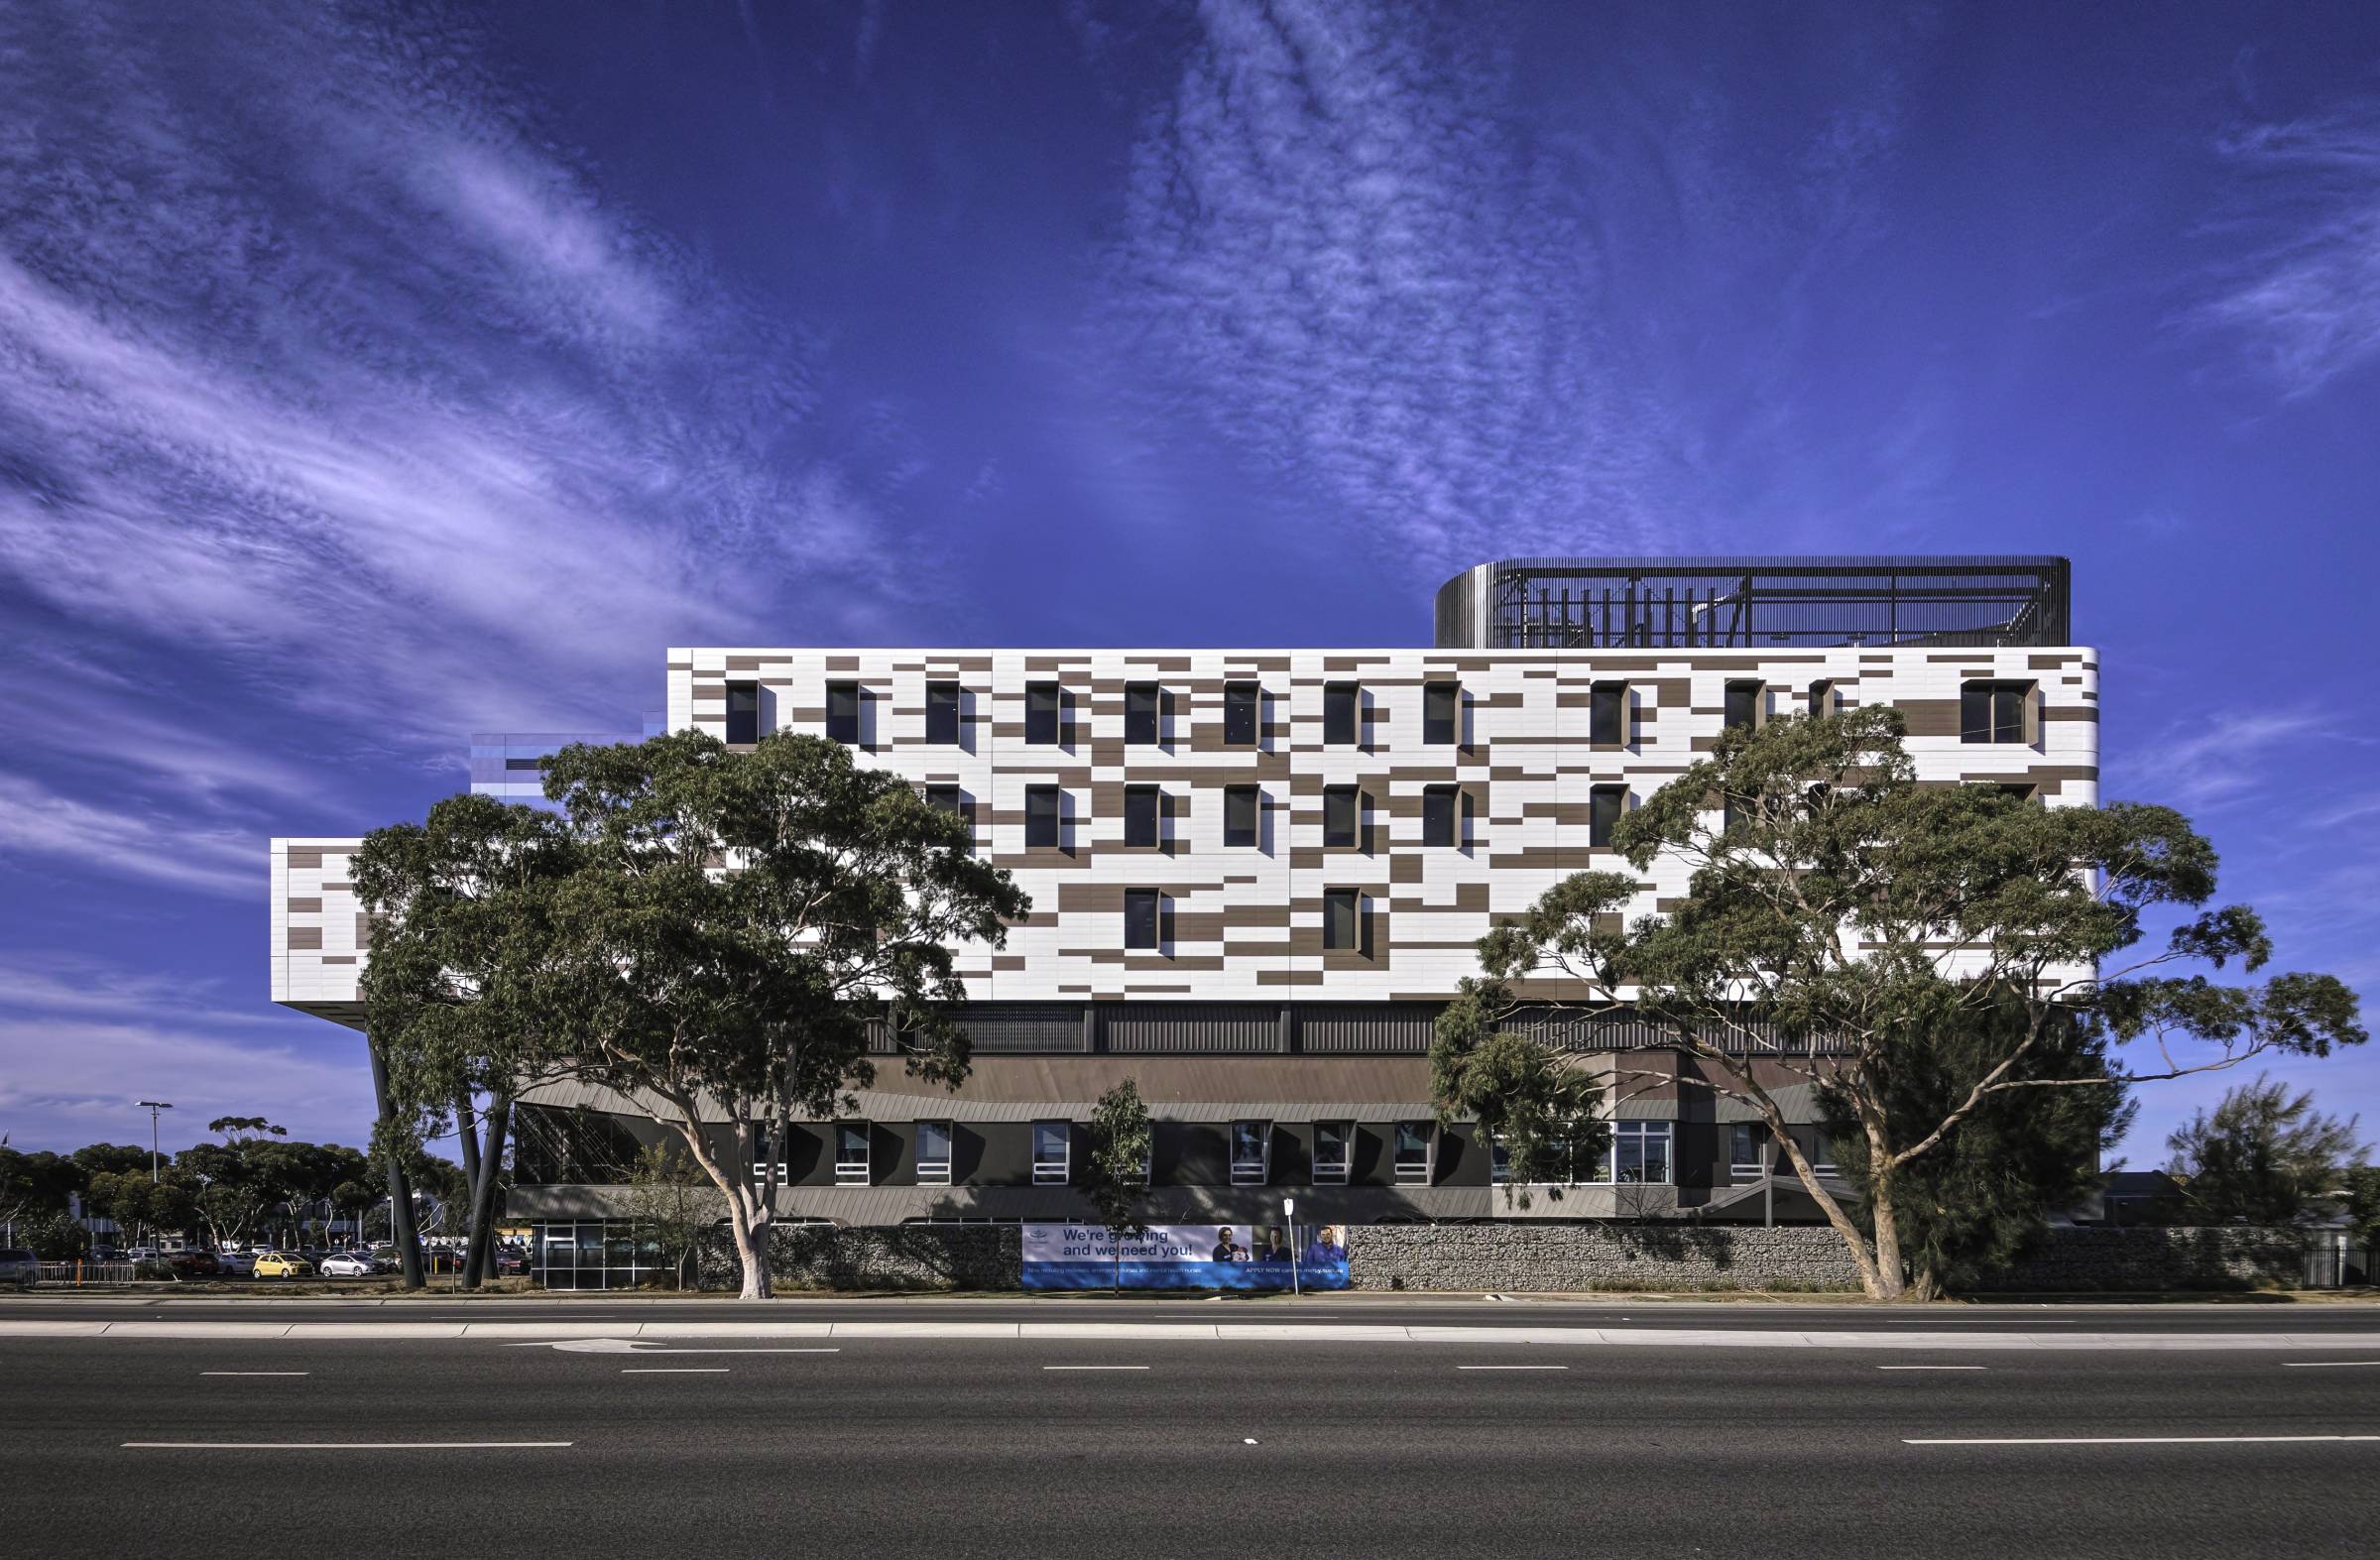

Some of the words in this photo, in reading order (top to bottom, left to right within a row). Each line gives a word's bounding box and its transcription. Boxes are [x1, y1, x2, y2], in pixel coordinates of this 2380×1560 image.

[1063, 1229, 1105, 1241] We're
[1063, 1244, 1091, 1256] and
[1096, 1247, 1116, 1256] we
[1121, 1244, 1157, 1256] need
[1161, 1244, 1193, 1259] you!
